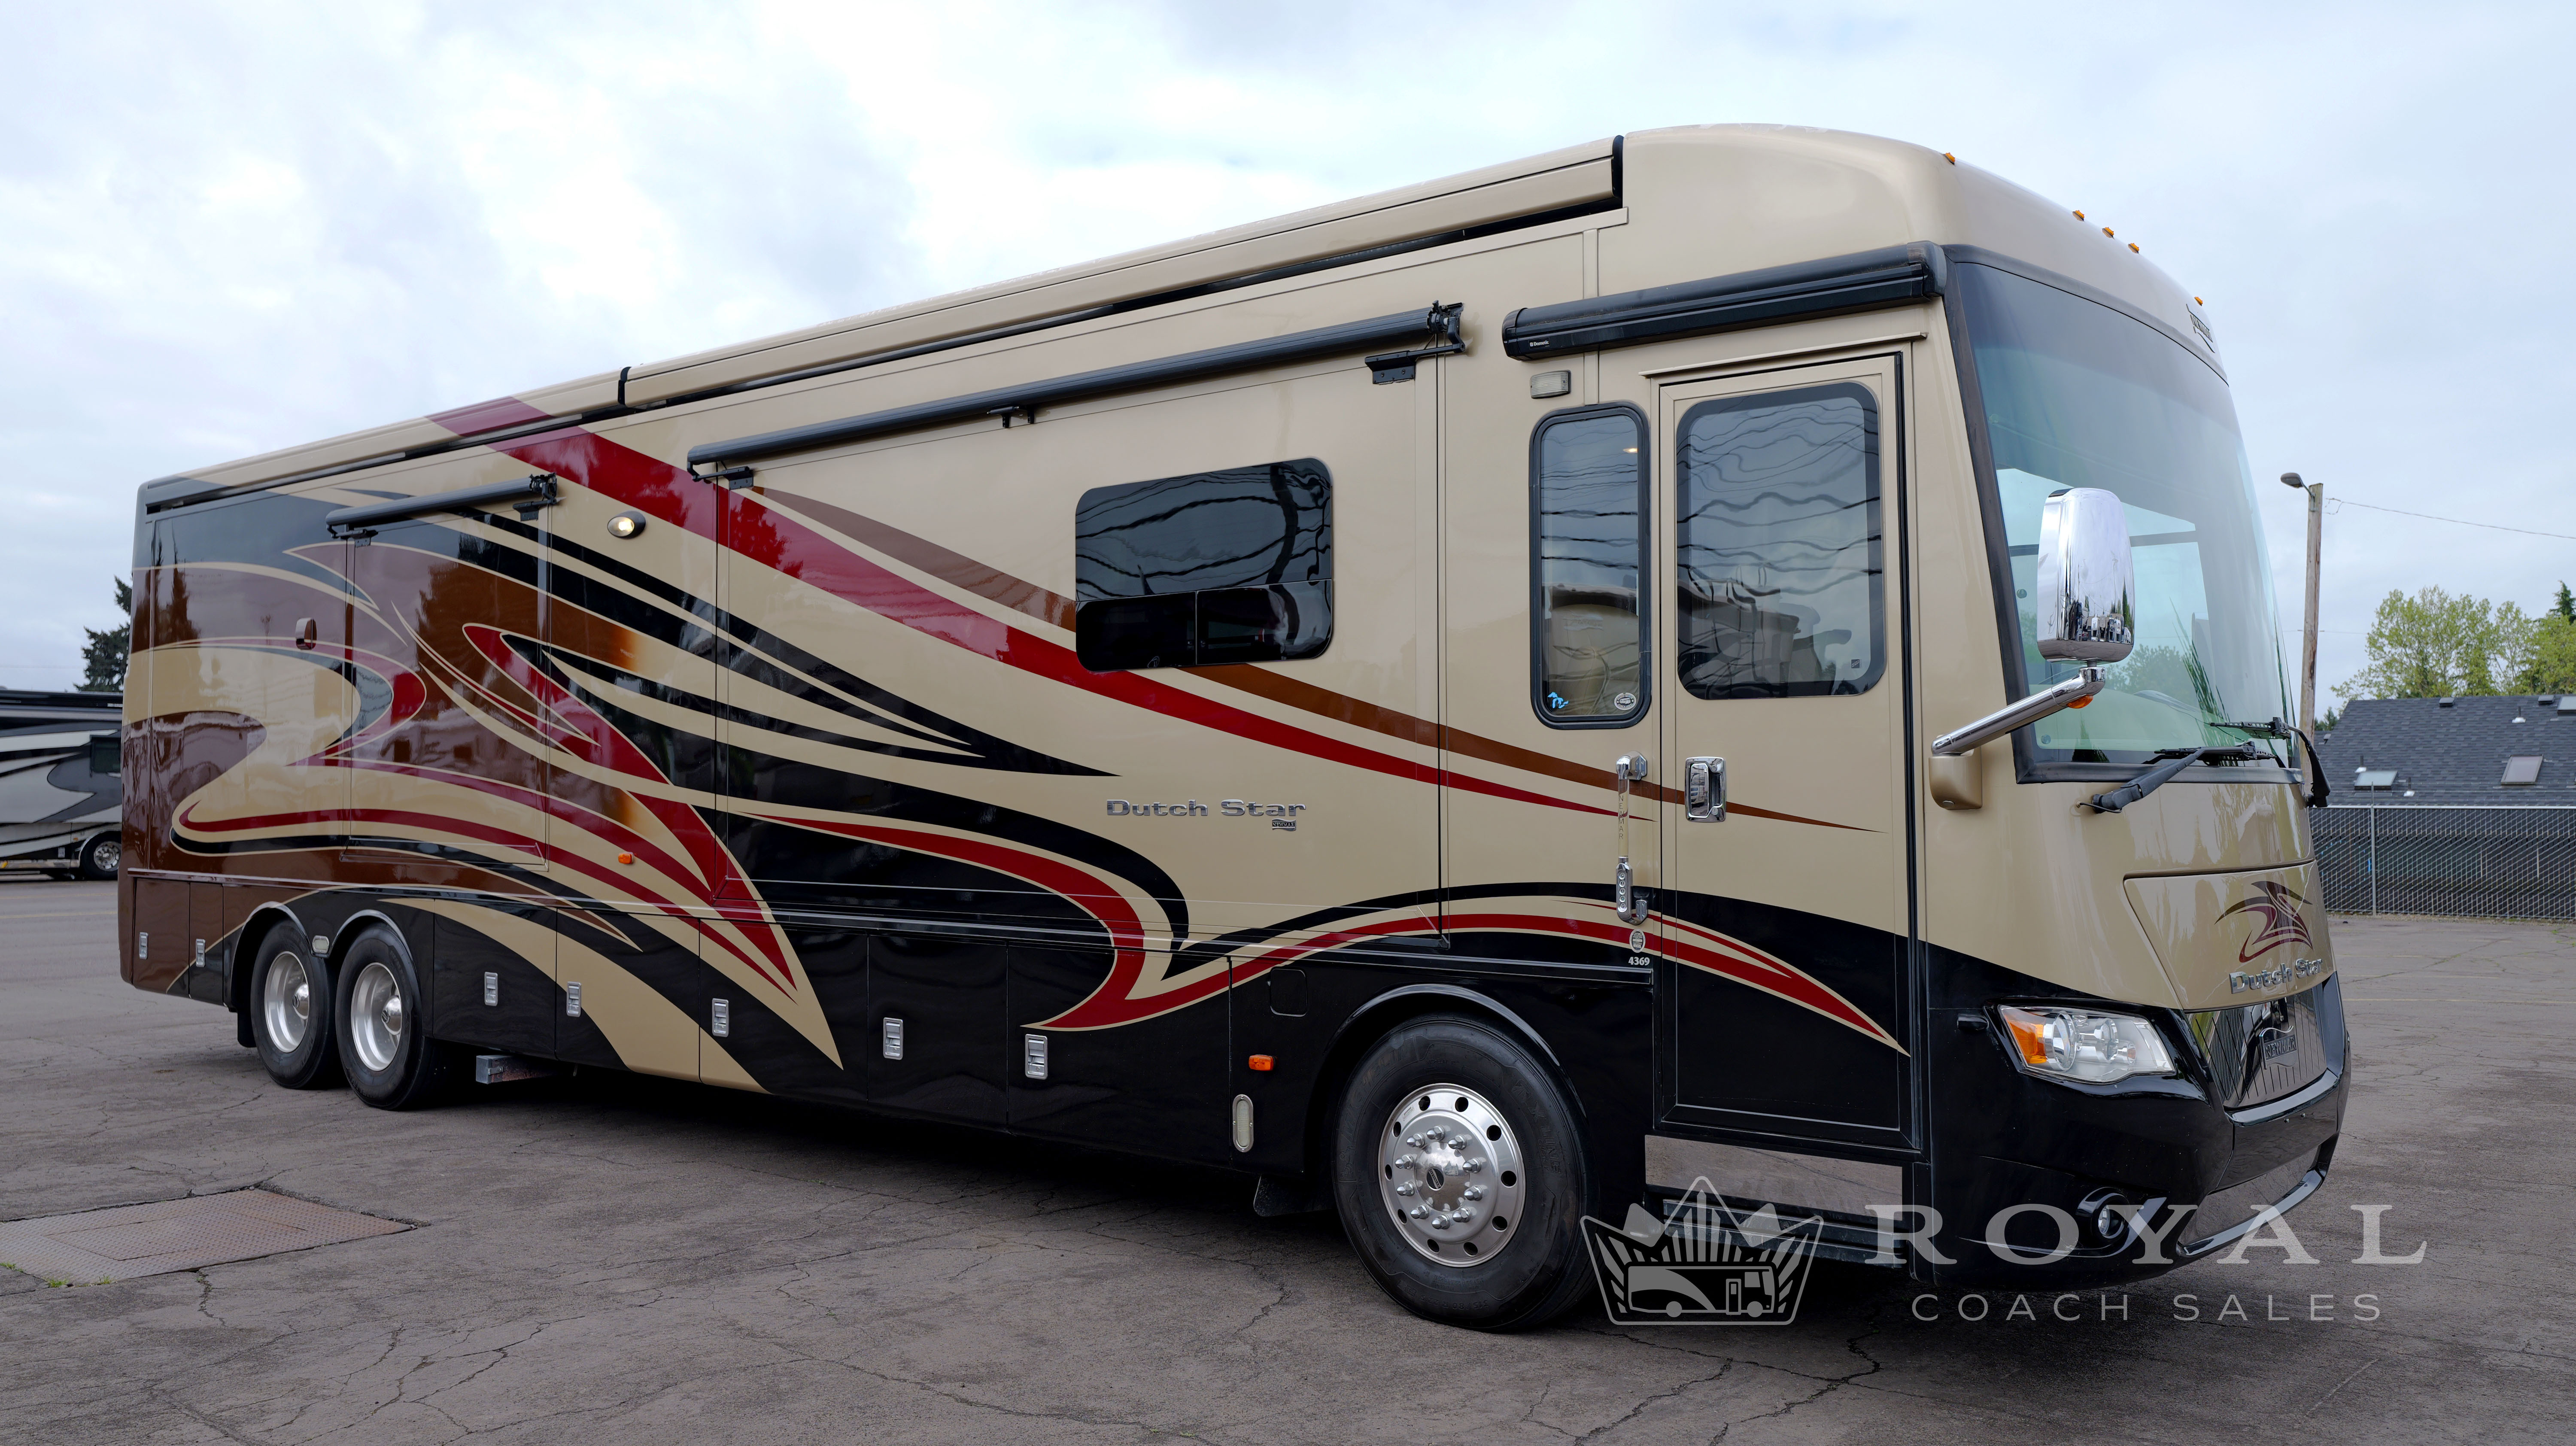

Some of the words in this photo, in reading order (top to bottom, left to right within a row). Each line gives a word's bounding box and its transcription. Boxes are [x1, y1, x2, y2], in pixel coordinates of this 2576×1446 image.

[1107, 799, 1208, 816] Dutch
[1221, 799, 1306, 816] Star
[1628, 957, 1650, 966] 4369
[2229, 963, 2292, 994] Dutch
[2295, 958, 2322, 978] Star
[2265, 1037, 2296, 1058] NEWMAR
